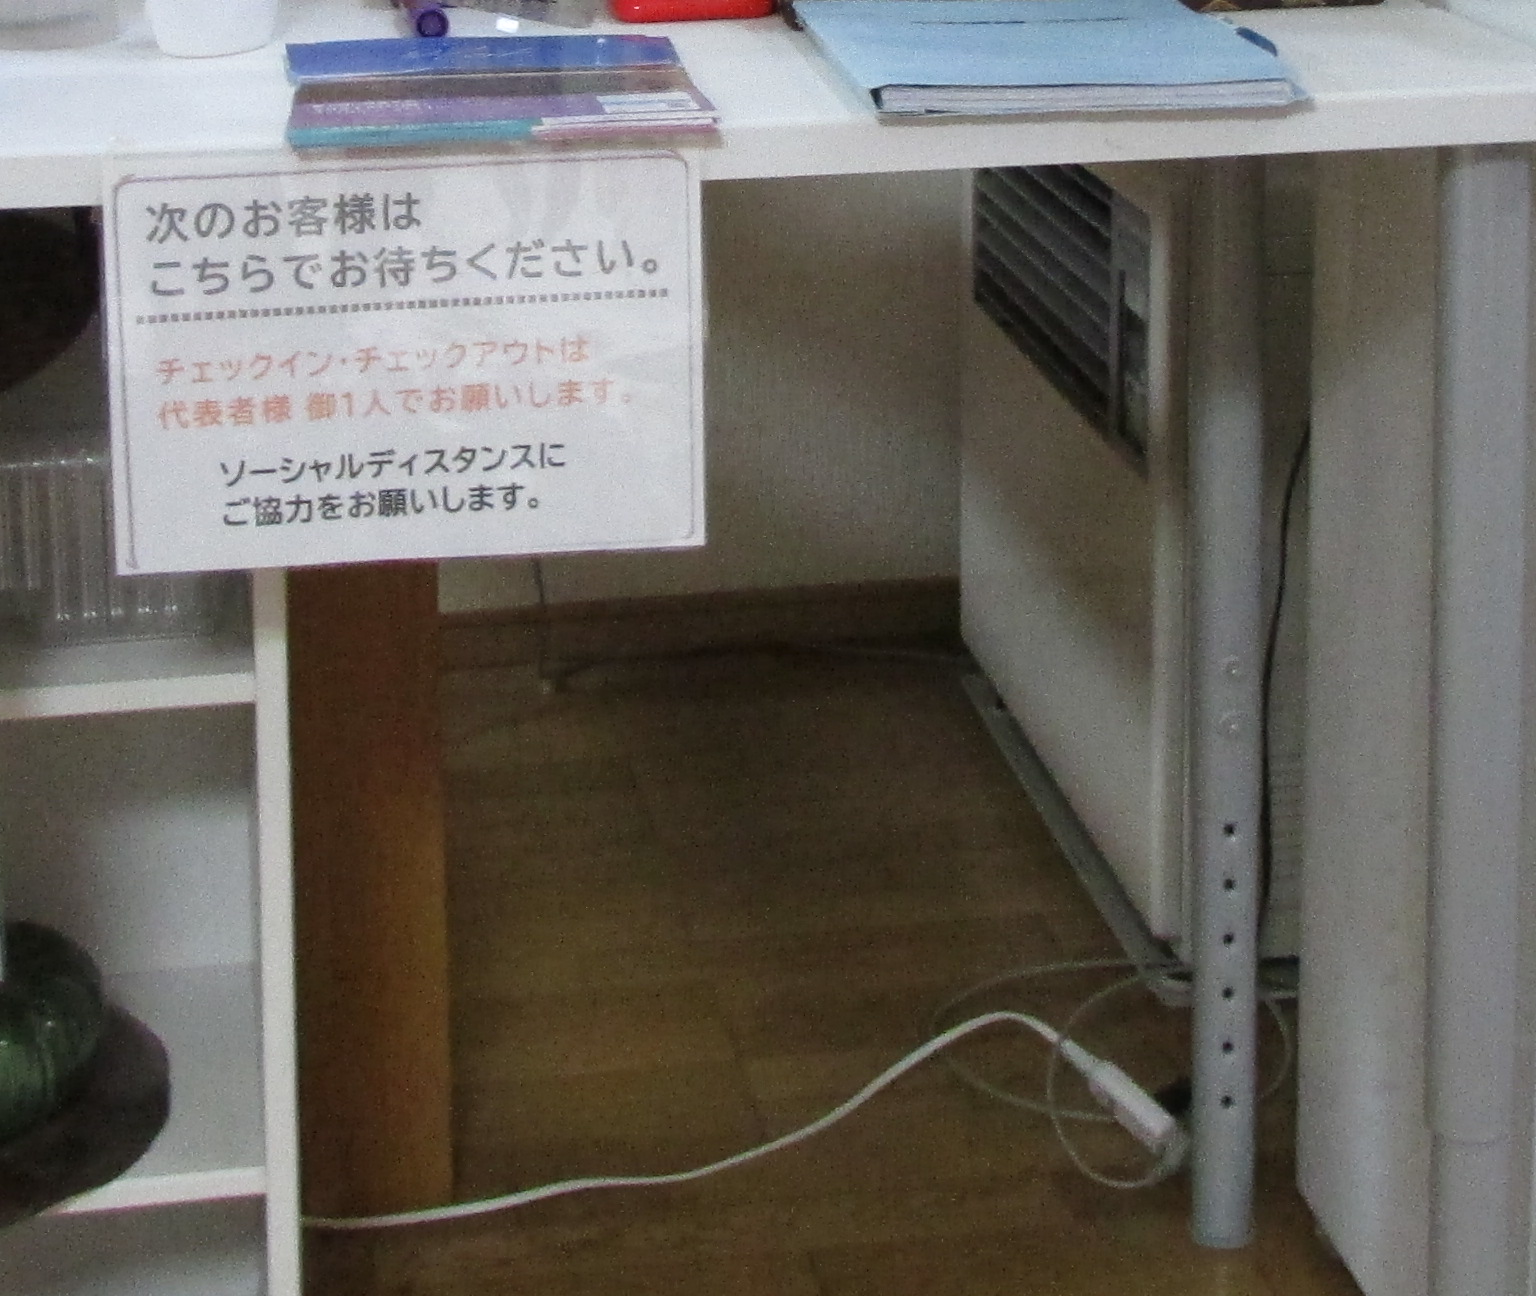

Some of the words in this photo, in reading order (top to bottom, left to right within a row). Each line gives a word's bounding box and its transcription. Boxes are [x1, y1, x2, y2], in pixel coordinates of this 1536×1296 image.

[146, 192, 422, 244] 次のお客様は
[150, 239, 662, 299] こちらでお待ちください。
[219, 442, 566, 487] ソーシャルディスタンスに
[221, 481, 543, 529] ご協力をお願いします。
